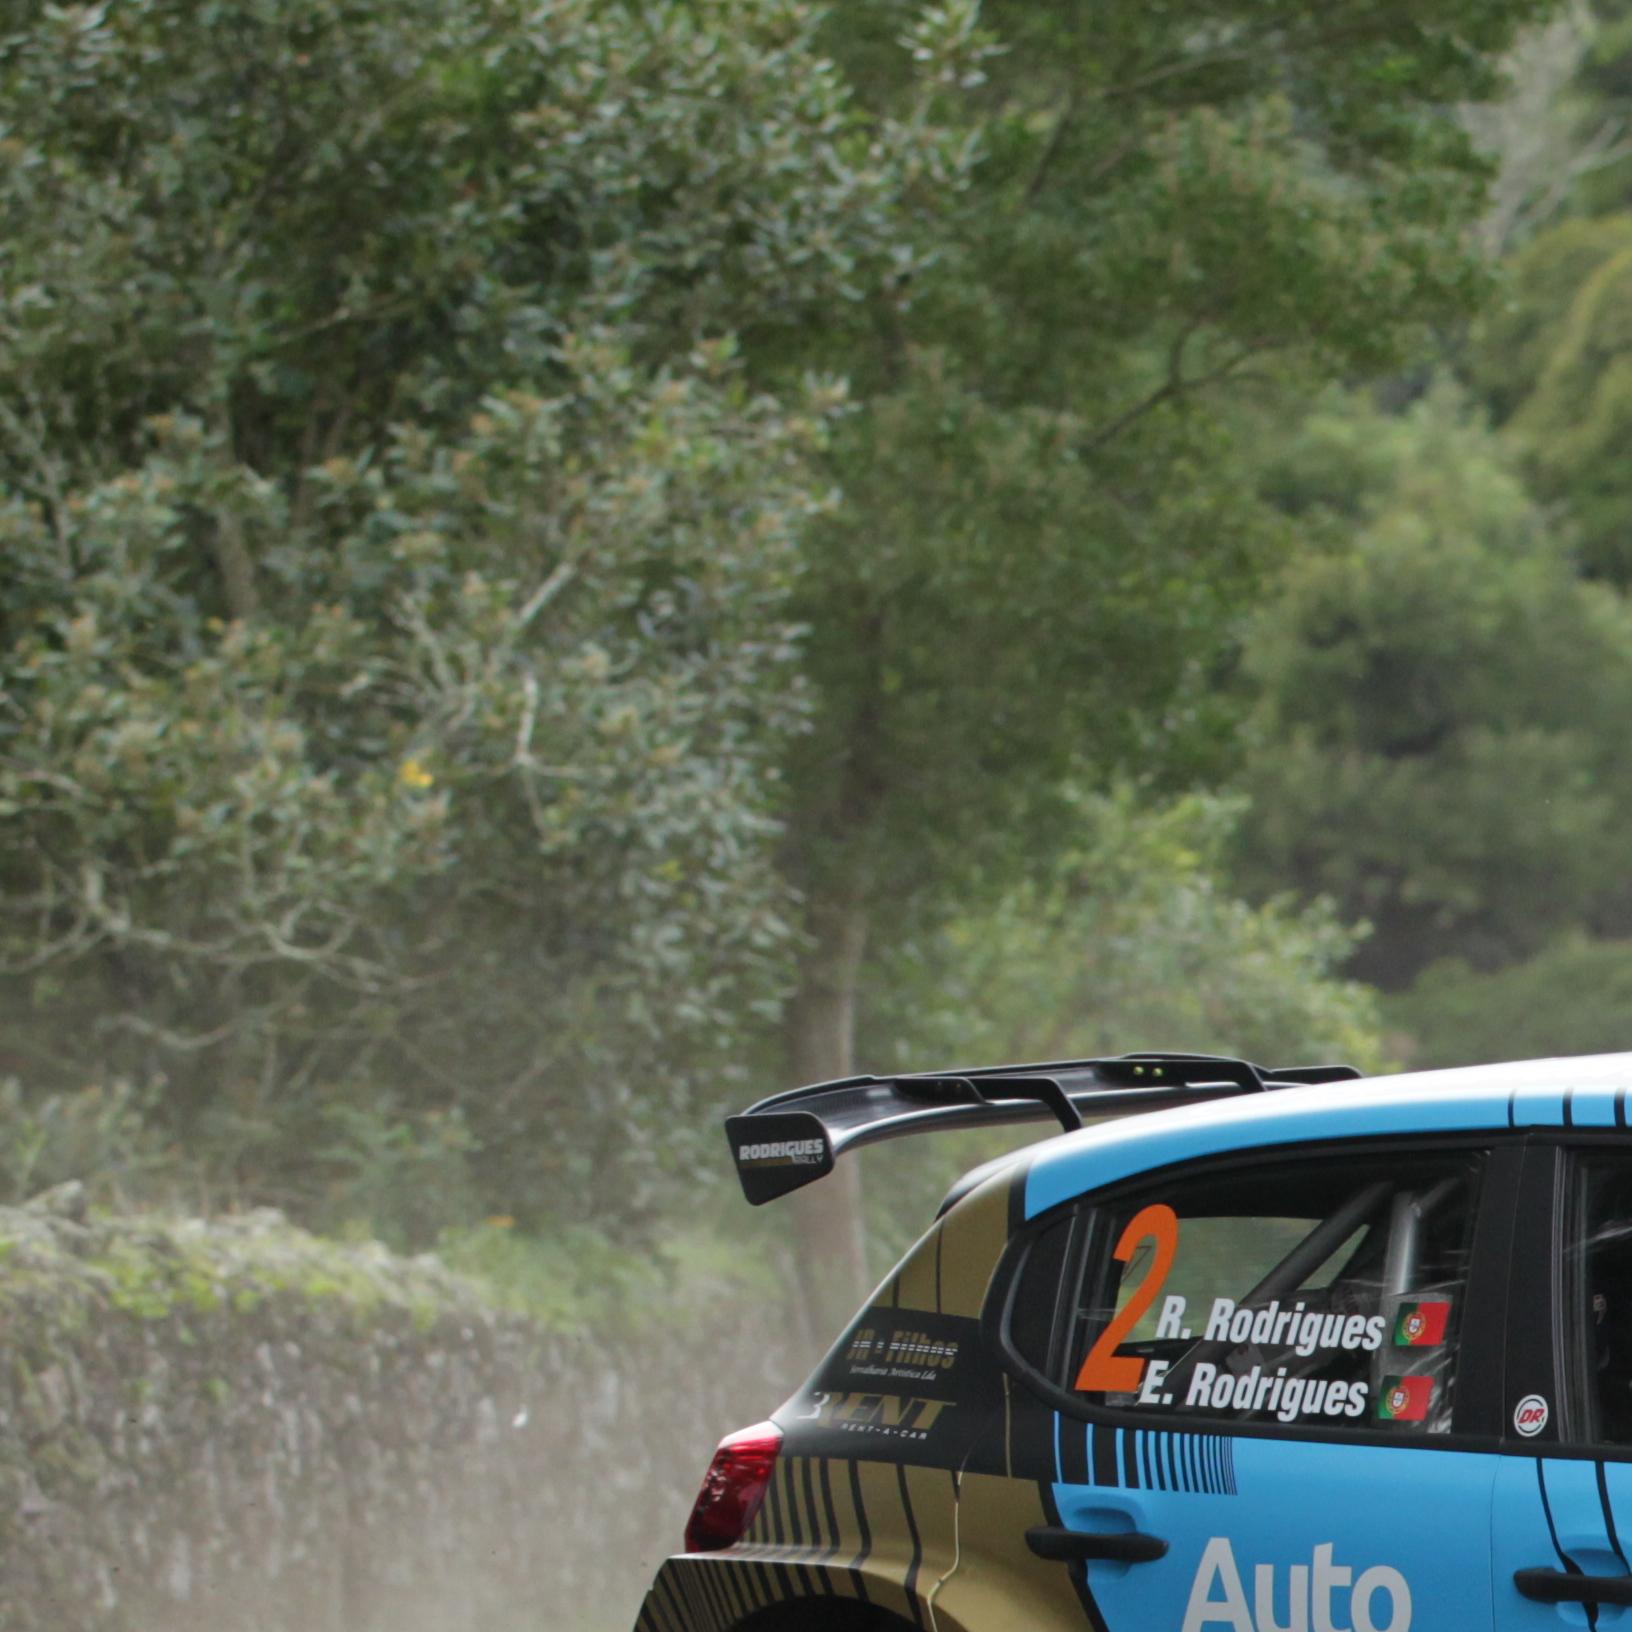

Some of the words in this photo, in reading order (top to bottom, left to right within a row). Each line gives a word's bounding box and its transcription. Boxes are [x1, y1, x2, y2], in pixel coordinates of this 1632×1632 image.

[739, 1139, 824, 1160] RODRIGUES
[1074, 1203, 1179, 1392] 2
[1155, 1295, 1191, 1340] R.
[1204, 1297, 1386, 1356] Rodrigues
[885, 1330, 959, 1369] Filhos
[1139, 1359, 1173, 1406] E.
[1185, 1362, 1369, 1423] Rodrigues
